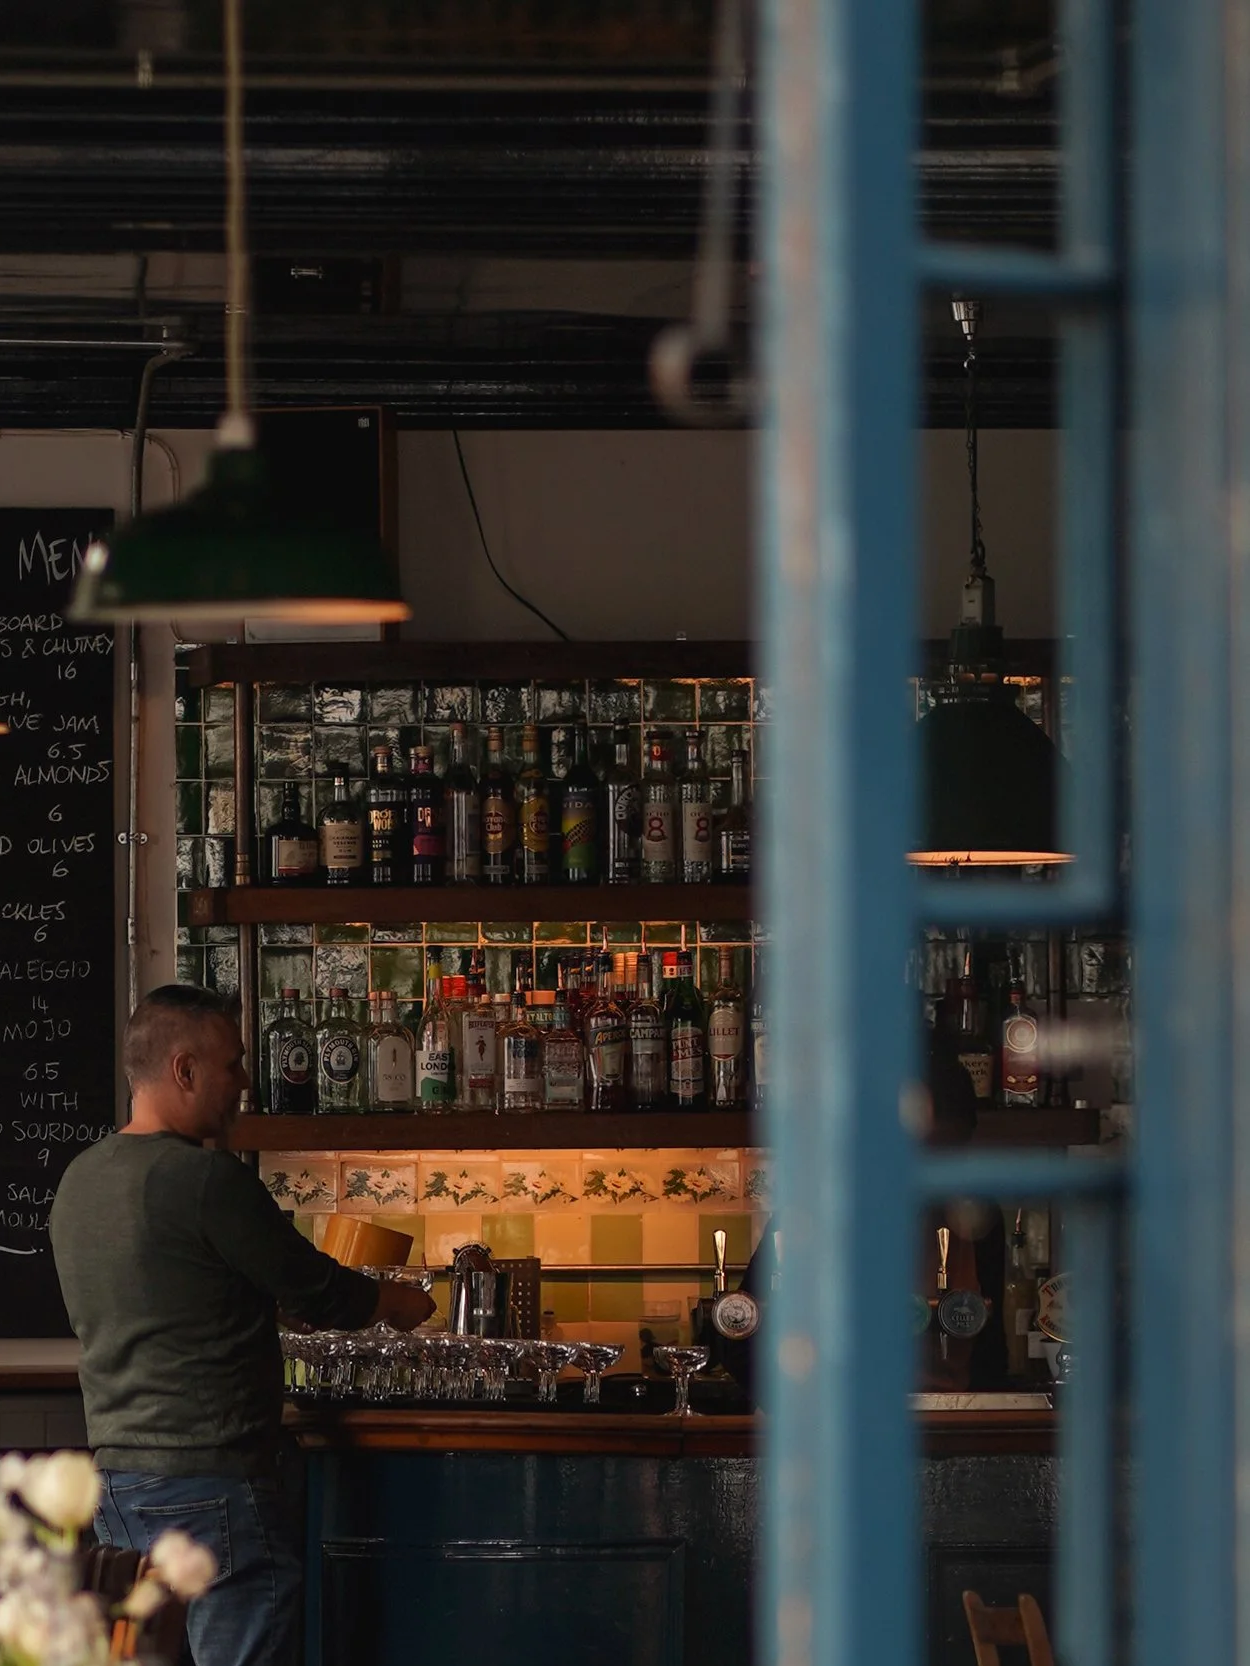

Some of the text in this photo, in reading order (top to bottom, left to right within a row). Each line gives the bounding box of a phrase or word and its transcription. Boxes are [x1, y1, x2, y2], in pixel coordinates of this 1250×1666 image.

[18, 530, 93, 585] MEN
[21, 638, 36, 659] &
[42, 633, 114, 657] CHUTNEY
[56, 660, 78, 680] 16
[7, 713, 100, 735] IVE JAM
[47, 742, 86, 760] 6.5
[14, 760, 112, 786] ALMONDS
[47, 804, 63, 822] 6
[27, 832, 96, 854] OLIVES
[52, 858, 69, 878] 6
[33, 924, 50, 942] 6
[31, 995, 49, 1014] 14
[2, 1018, 71, 1042] MOJO
[630, 1028, 662, 1039] CAMPA
[323, 1038, 354, 1061] PLYMOUTH
[23, 1061, 60, 1080] 6.5
[420, 1062, 450, 1070] LOND
[19, 1091, 79, 1111] WITH
[37, 1148, 51, 1168] 9
[6, 1183, 56, 1205] SALA
